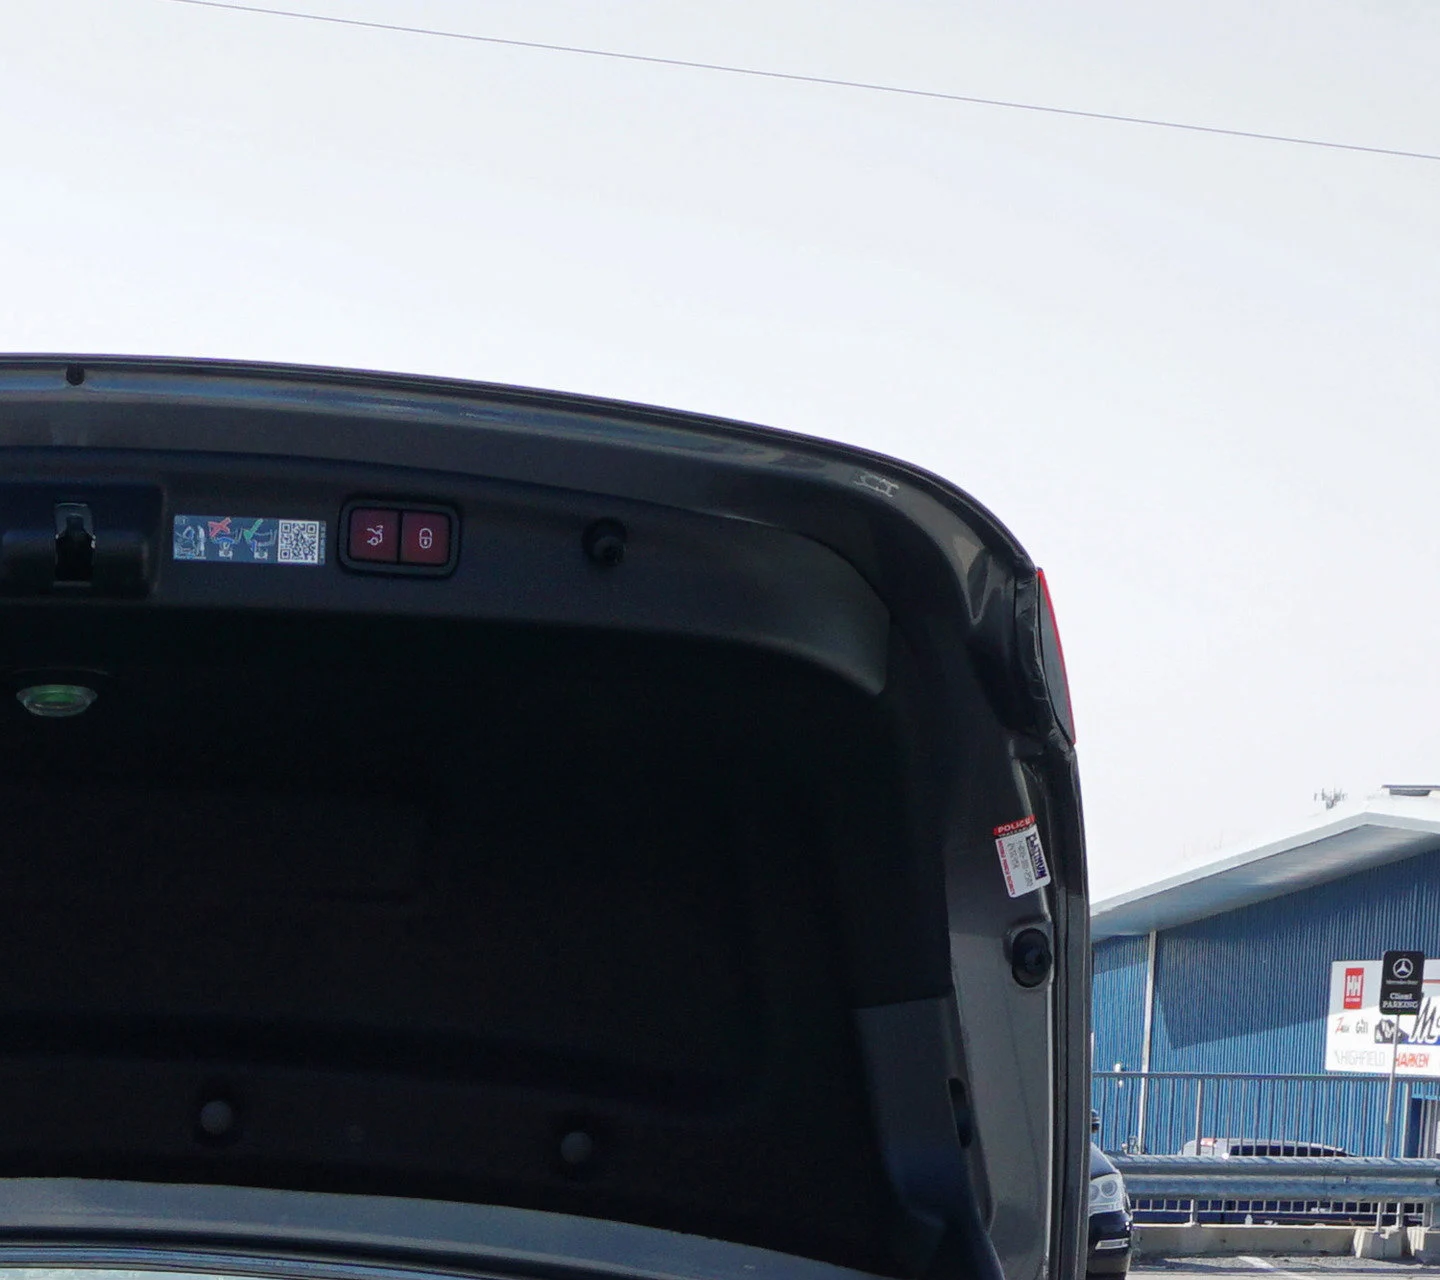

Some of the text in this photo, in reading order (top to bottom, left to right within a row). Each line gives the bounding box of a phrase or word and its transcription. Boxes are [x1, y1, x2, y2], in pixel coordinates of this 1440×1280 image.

[997, 817, 1032, 833] POLICE
[1389, 992, 1413, 1000] Client
[1382, 1000, 1418, 1009] PARKING
